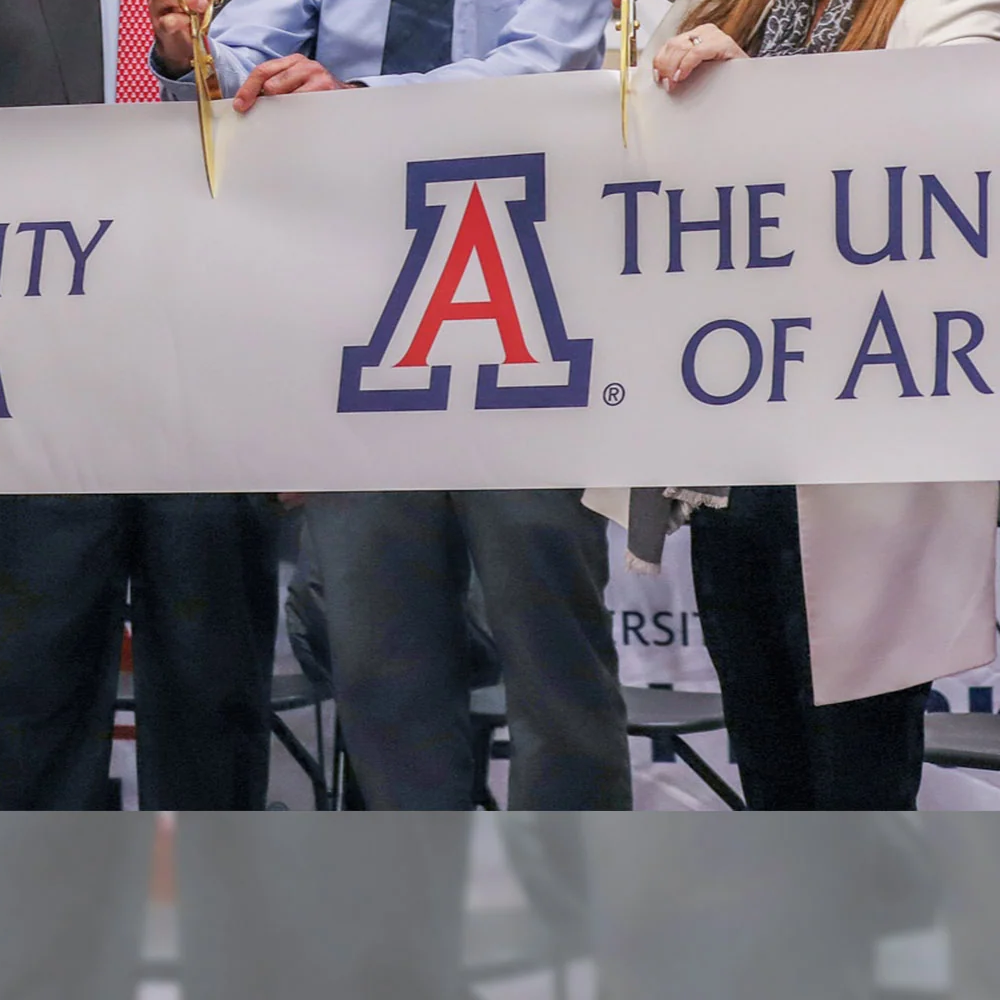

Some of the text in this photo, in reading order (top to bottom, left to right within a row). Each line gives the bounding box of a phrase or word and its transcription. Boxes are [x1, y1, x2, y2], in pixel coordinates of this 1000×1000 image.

[601, 180, 795, 275] THE
[681, 316, 812, 405] OF
[611, 610, 699, 646] RSI
